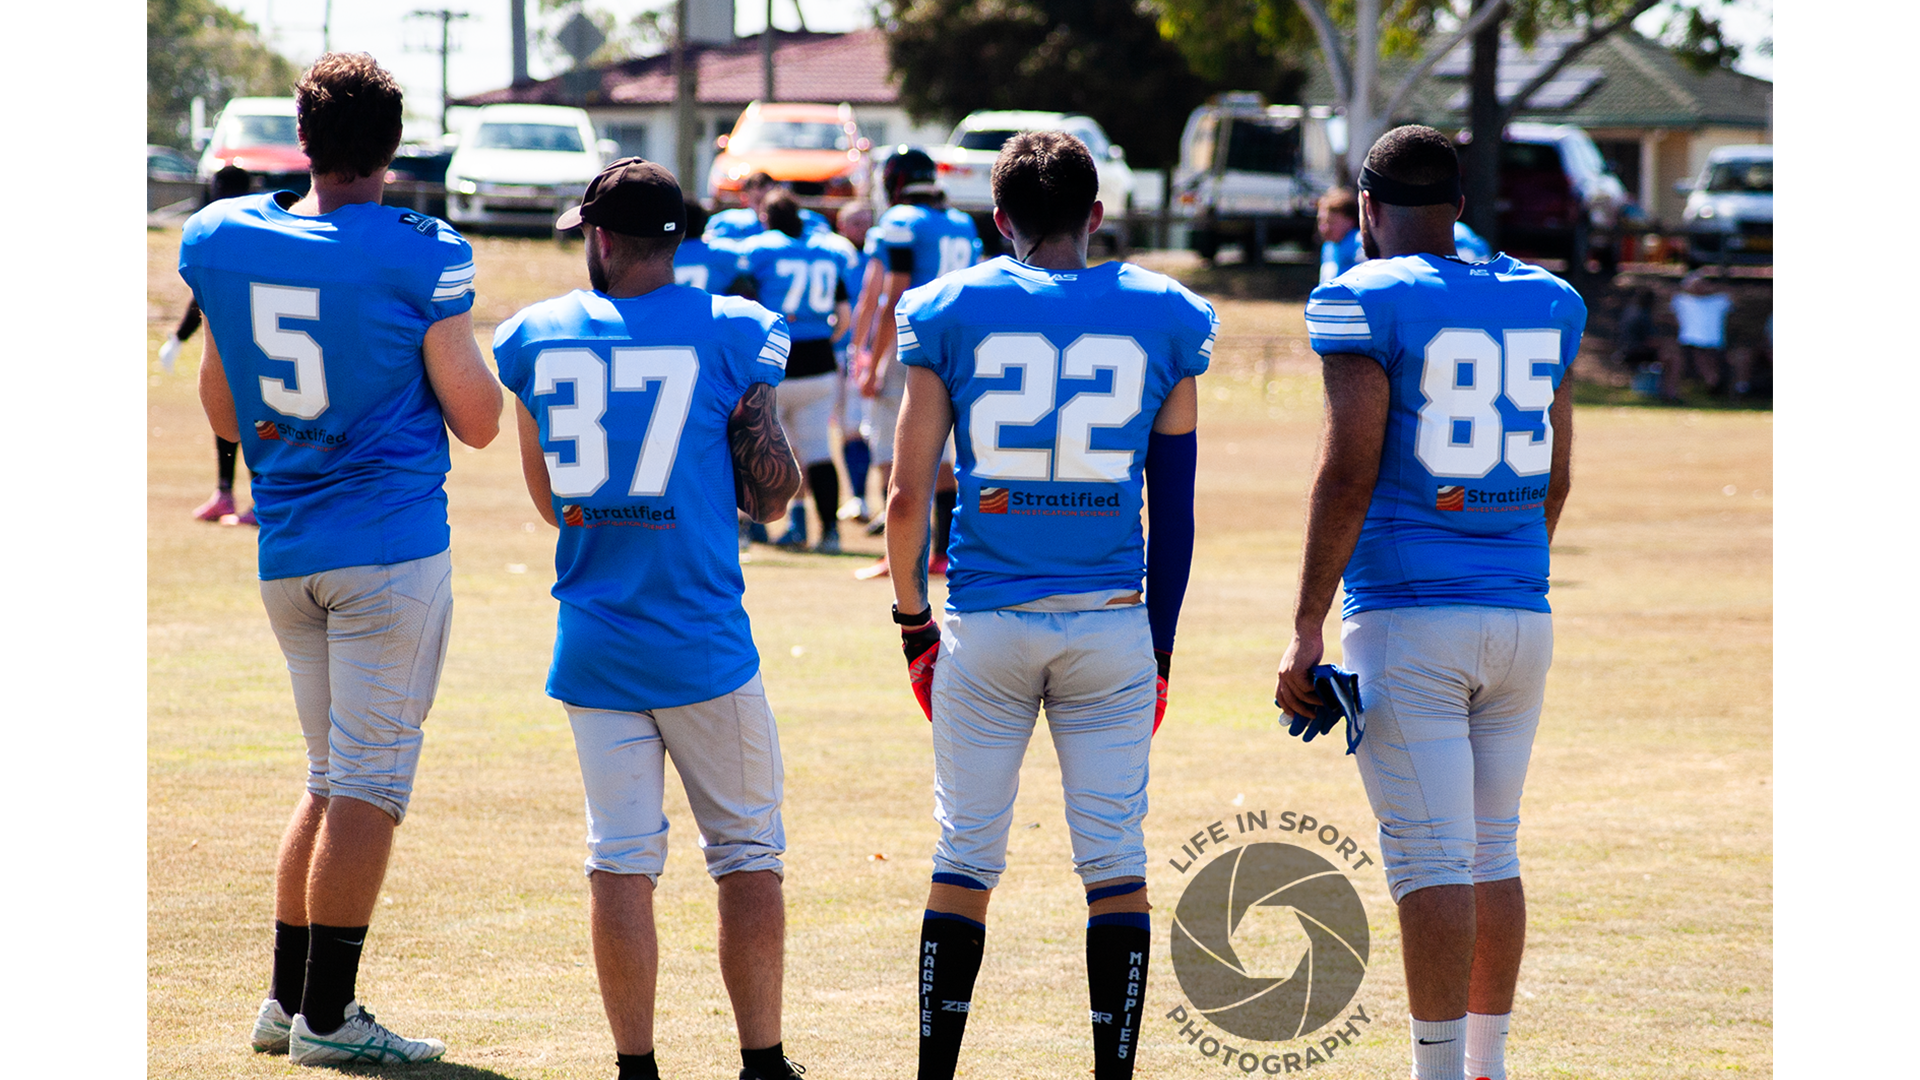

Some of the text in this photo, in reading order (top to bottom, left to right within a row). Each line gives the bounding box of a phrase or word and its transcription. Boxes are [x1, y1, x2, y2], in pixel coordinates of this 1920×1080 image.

[775, 258, 838, 314] 70
[250, 282, 329, 420] 5
[534, 345, 700, 498] 37
[969, 332, 1148, 482] 22
[1414, 327, 1561, 478] 85
[278, 423, 347, 445] Stratified
[584, 505, 676, 521] Stratified
[1011, 509, 1077, 517] INVESTIGATION
[1012, 491, 1120, 507] Stratified
[1466, 505, 1519, 513] INVESTIGATION
[1467, 484, 1546, 503] Stratified
[922, 941, 938, 1037] MAGPIES
[1117, 951, 1143, 1059] MAGPIES
